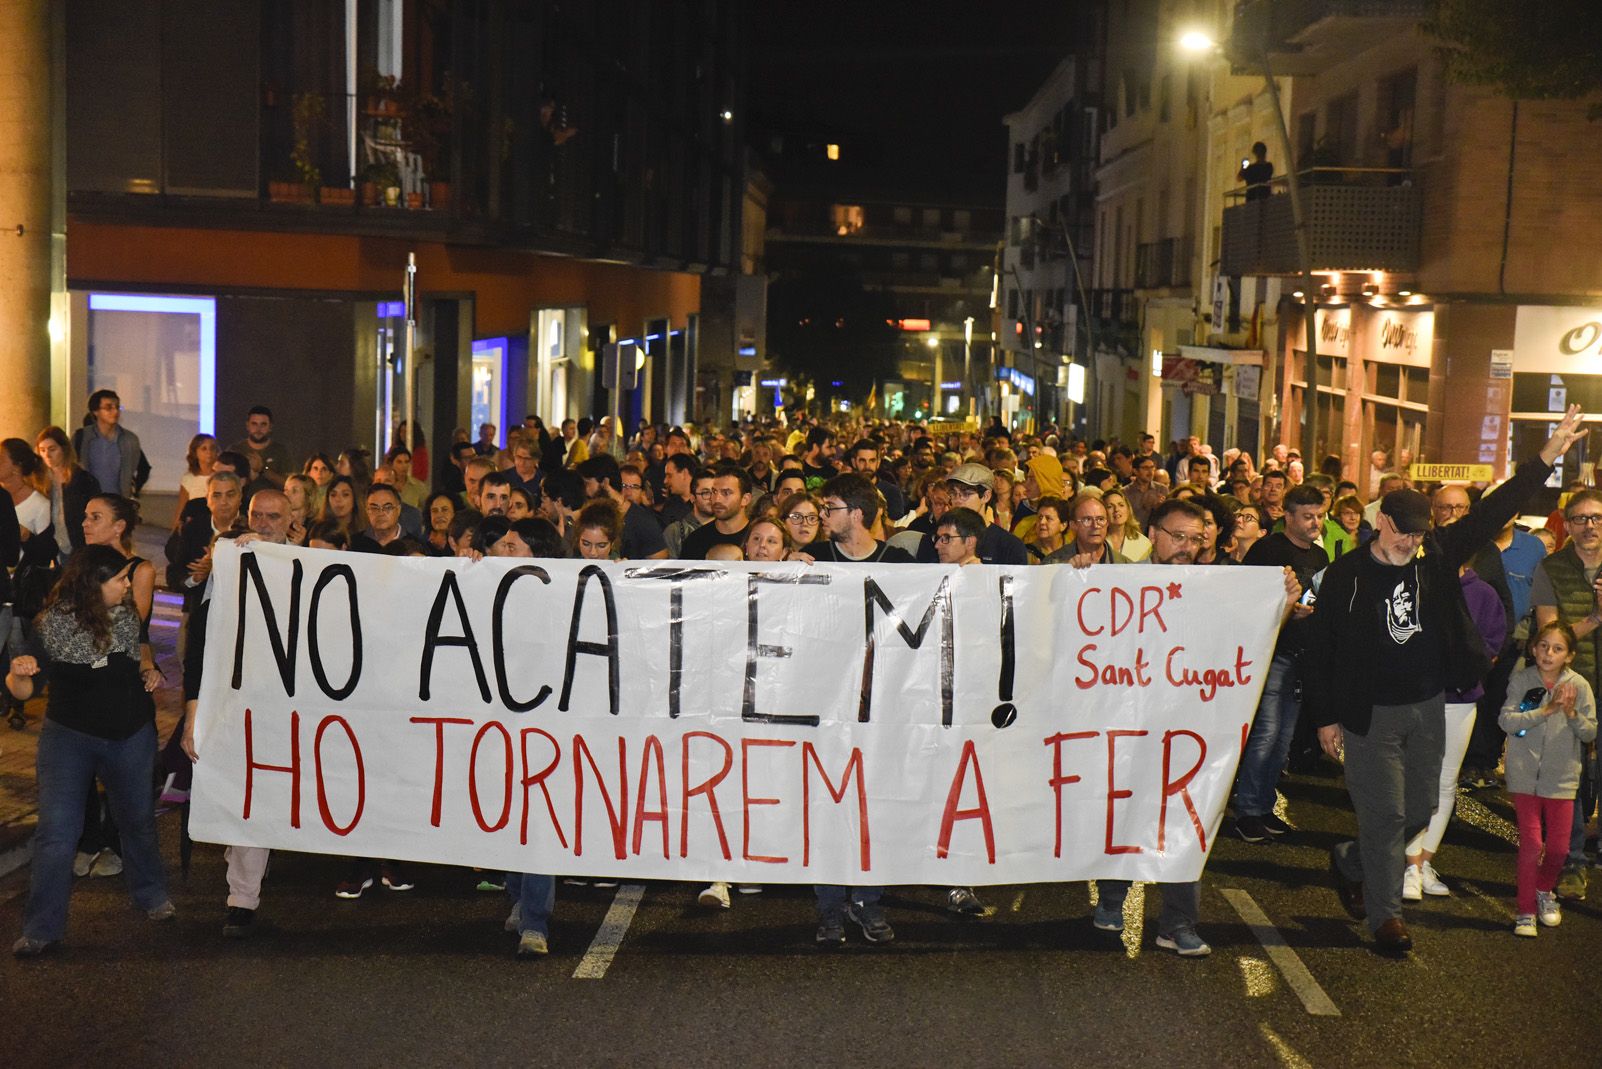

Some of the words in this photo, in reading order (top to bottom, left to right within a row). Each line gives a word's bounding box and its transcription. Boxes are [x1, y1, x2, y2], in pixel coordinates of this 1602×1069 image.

[1416, 465, 1471, 479] LLIBERTAT!
[231, 551, 363, 701] NO
[418, 564, 1018, 730] ACATEM!
[1075, 643, 1152, 690] Sant
[1165, 645, 1253, 702] Cugat
[242, 707, 366, 836] HO
[408, 716, 872, 872] TORNAREM
[936, 738, 996, 865] A
